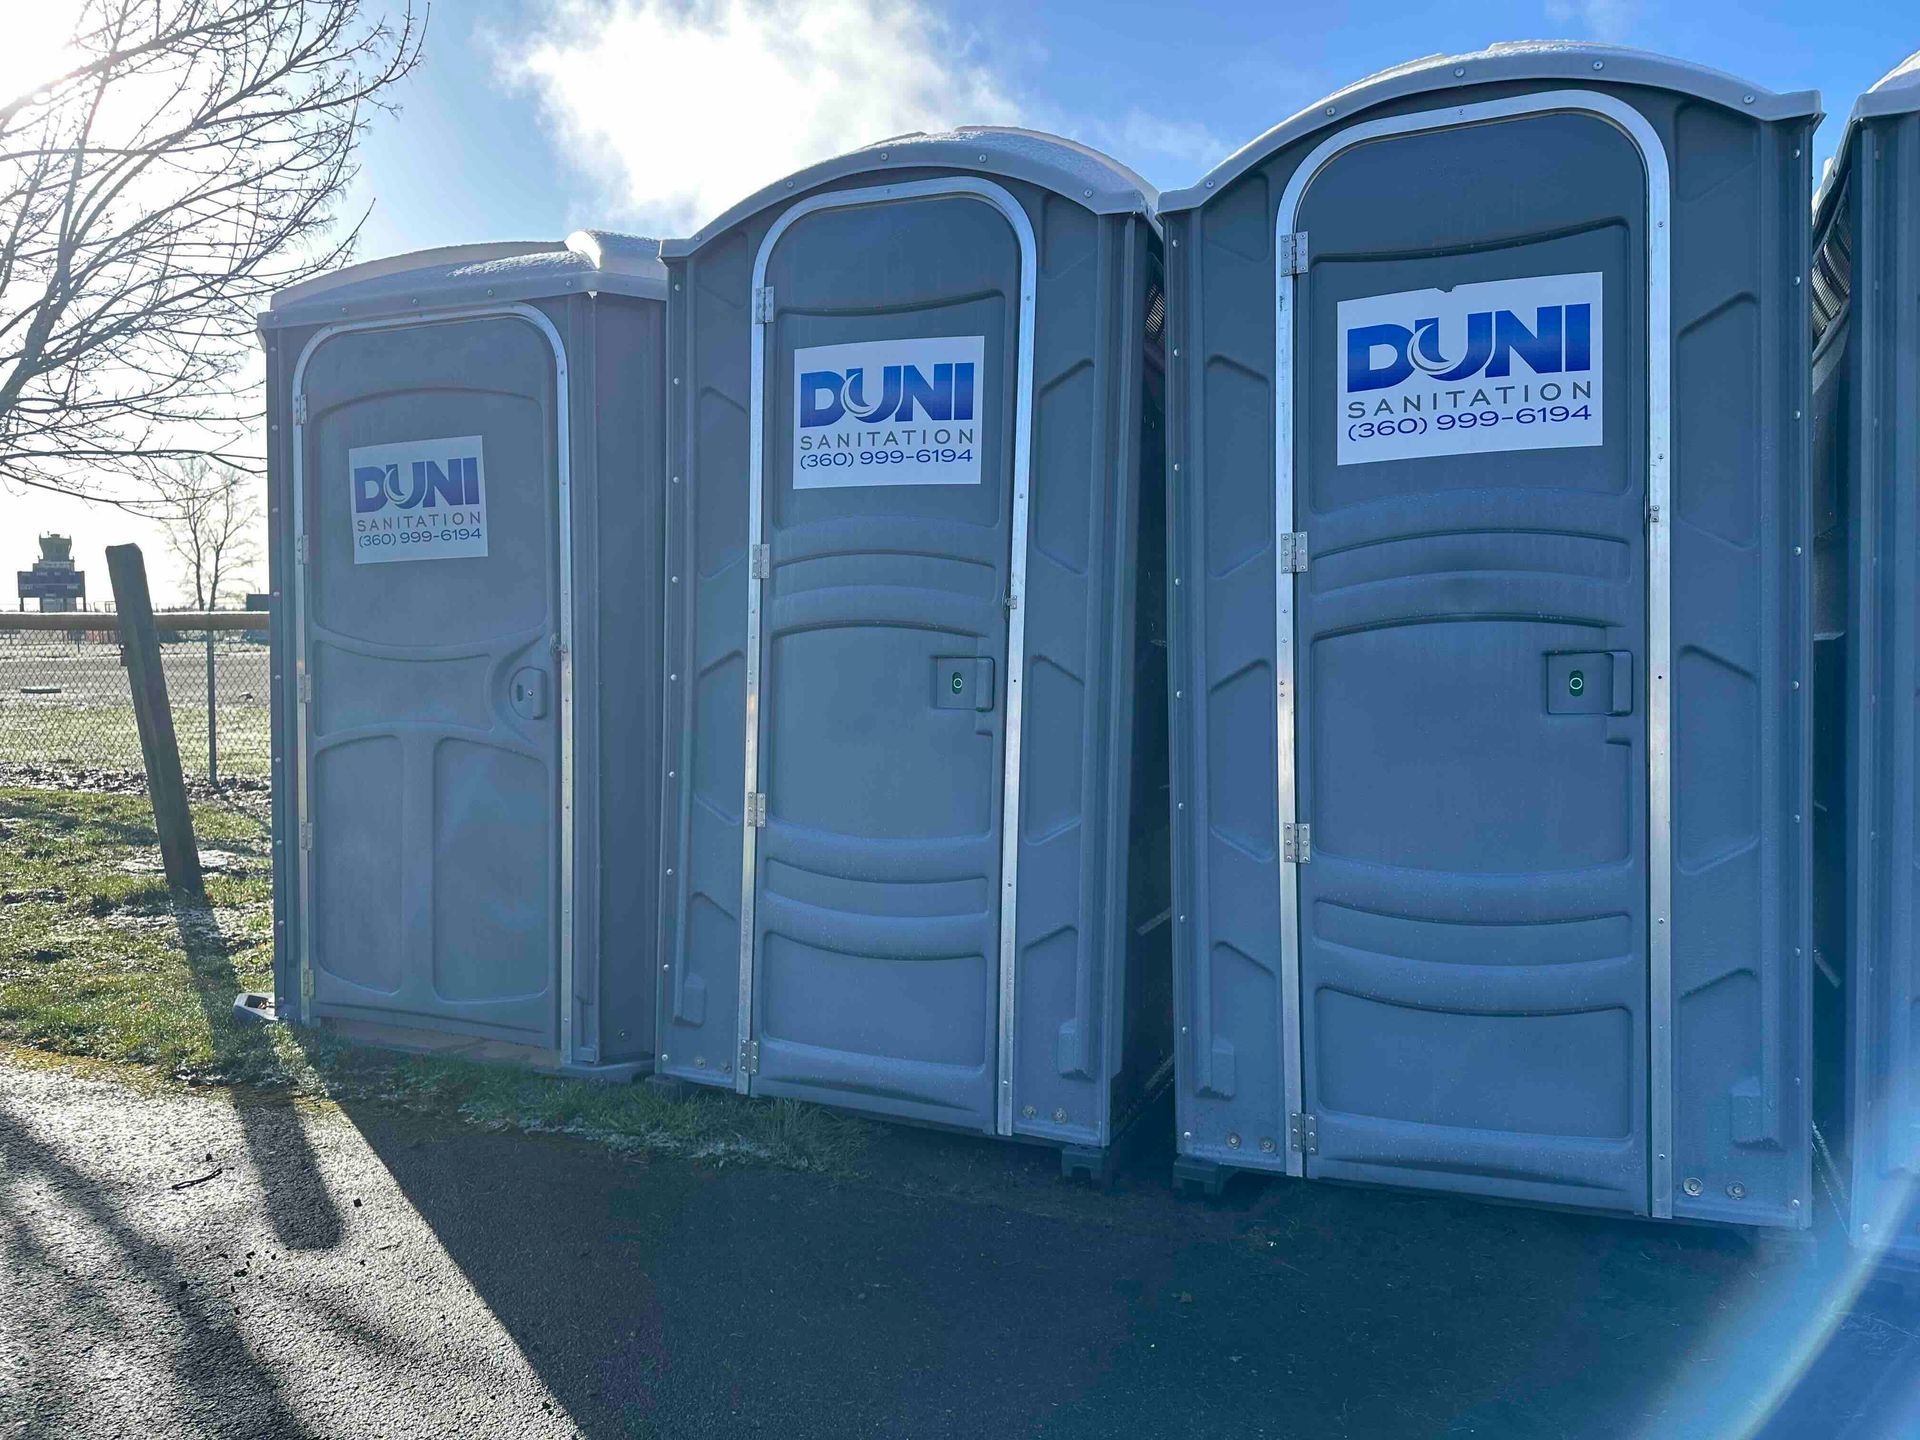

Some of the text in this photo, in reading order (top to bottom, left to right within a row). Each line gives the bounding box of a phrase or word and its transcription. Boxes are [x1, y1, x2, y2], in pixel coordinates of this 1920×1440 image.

[1347, 303, 1591, 393] DUNI
[800, 362, 974, 428] DUNI
[1347, 380, 1592, 419] SANITATION
[800, 428, 973, 450] SANITATION
[1347, 405, 1592, 442] (360) 999-6194
[800, 449, 973, 470] (360) 999-6194
[354, 457, 479, 513] DUNI
[357, 512, 480, 532] SANITATION
[359, 528, 482, 548] (360) 999-6194
